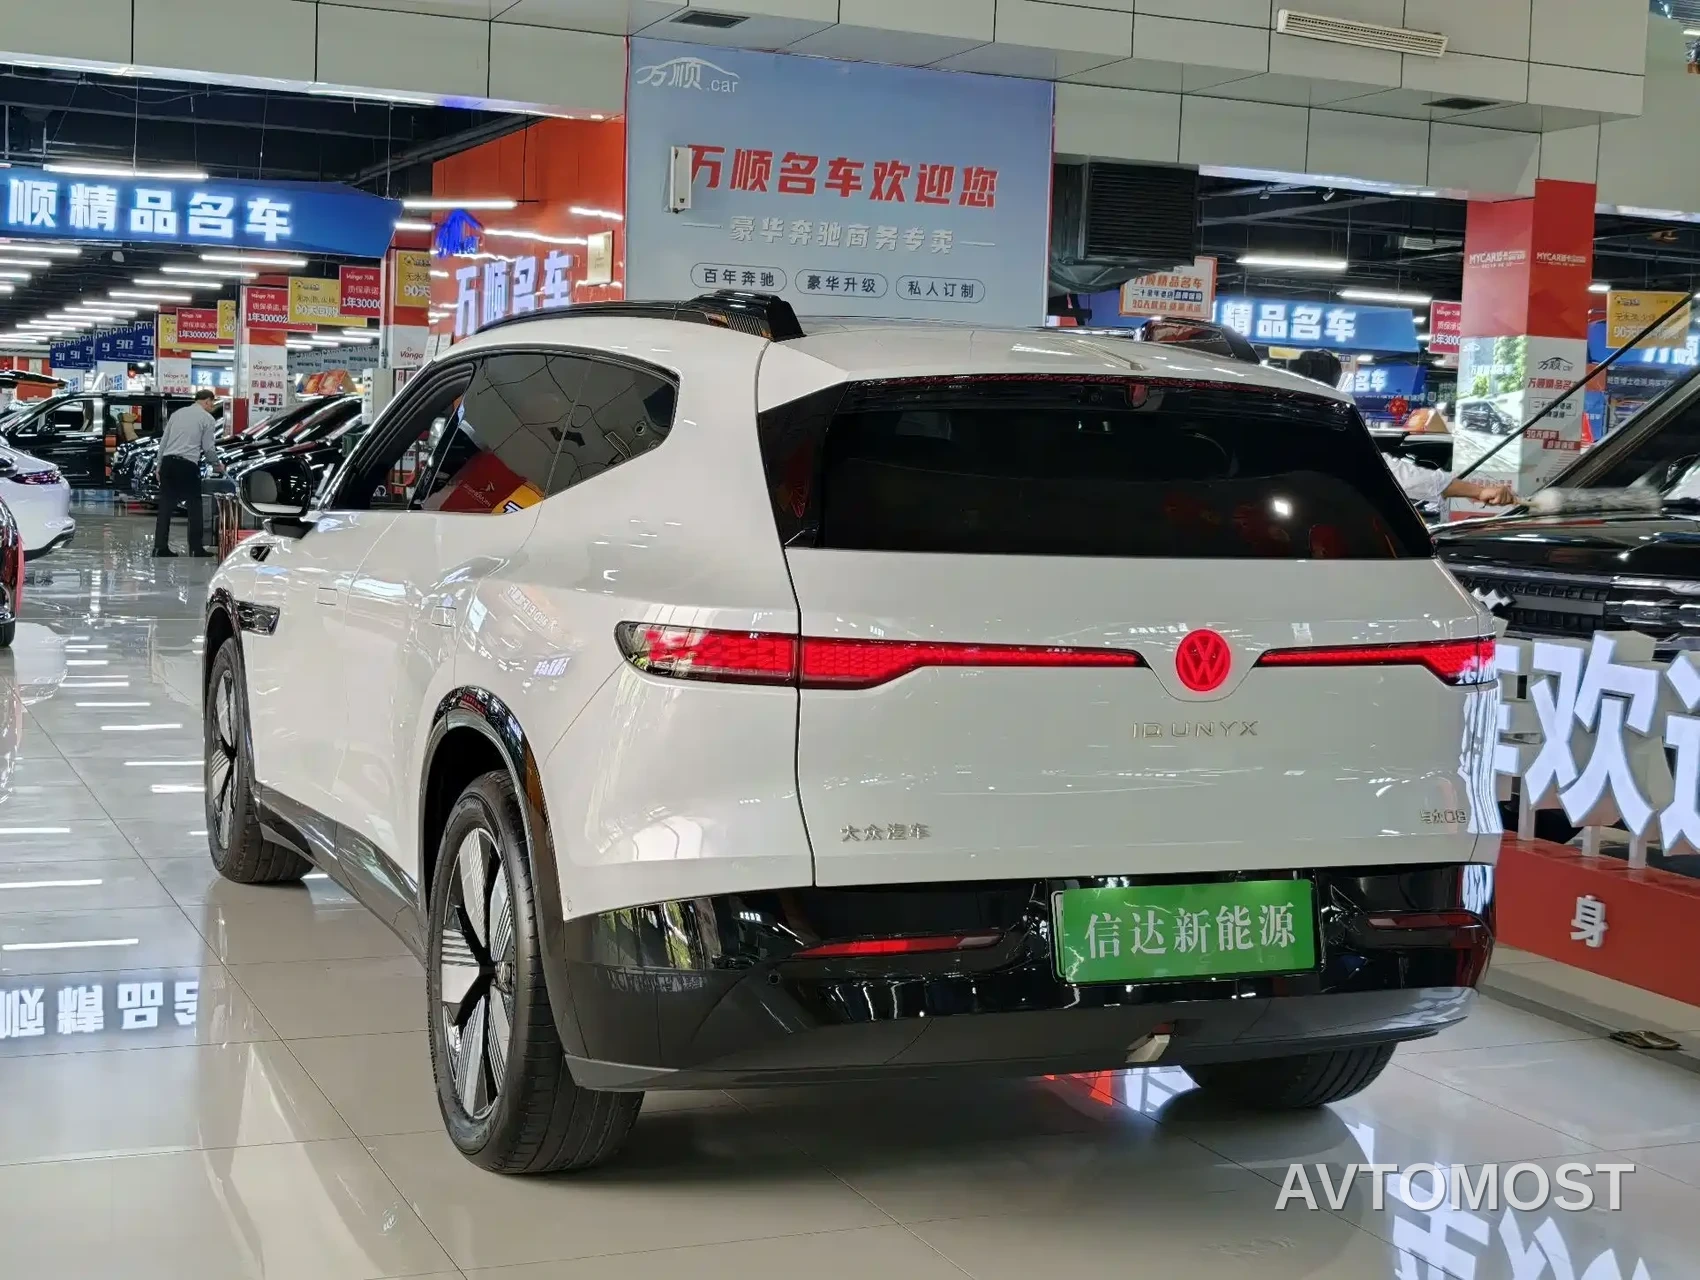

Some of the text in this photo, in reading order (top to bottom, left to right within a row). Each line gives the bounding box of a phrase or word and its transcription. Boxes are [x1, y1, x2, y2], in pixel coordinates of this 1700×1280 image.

[688, 143, 998, 208] 万顺名车欢迎您
[9, 179, 292, 242] 顺精品名车
[730, 215, 954, 254] 豪华奔驰商务专卖
[455, 250, 572, 336] 万顺名车
[703, 268, 775, 287] 百年奔驰
[807, 274, 876, 293] 豪华升级
[907, 281, 975, 299] 私人订制
[1213, 301, 1357, 342] 精品名车
[1528, 377, 1578, 390] 万顺精品名
[1172, 720, 1259, 738] UNYX
[840, 823, 931, 842] 大众汽车
[1084, 902, 1296, 959] 信达新能源
[1570, 895, 1608, 948] 身
